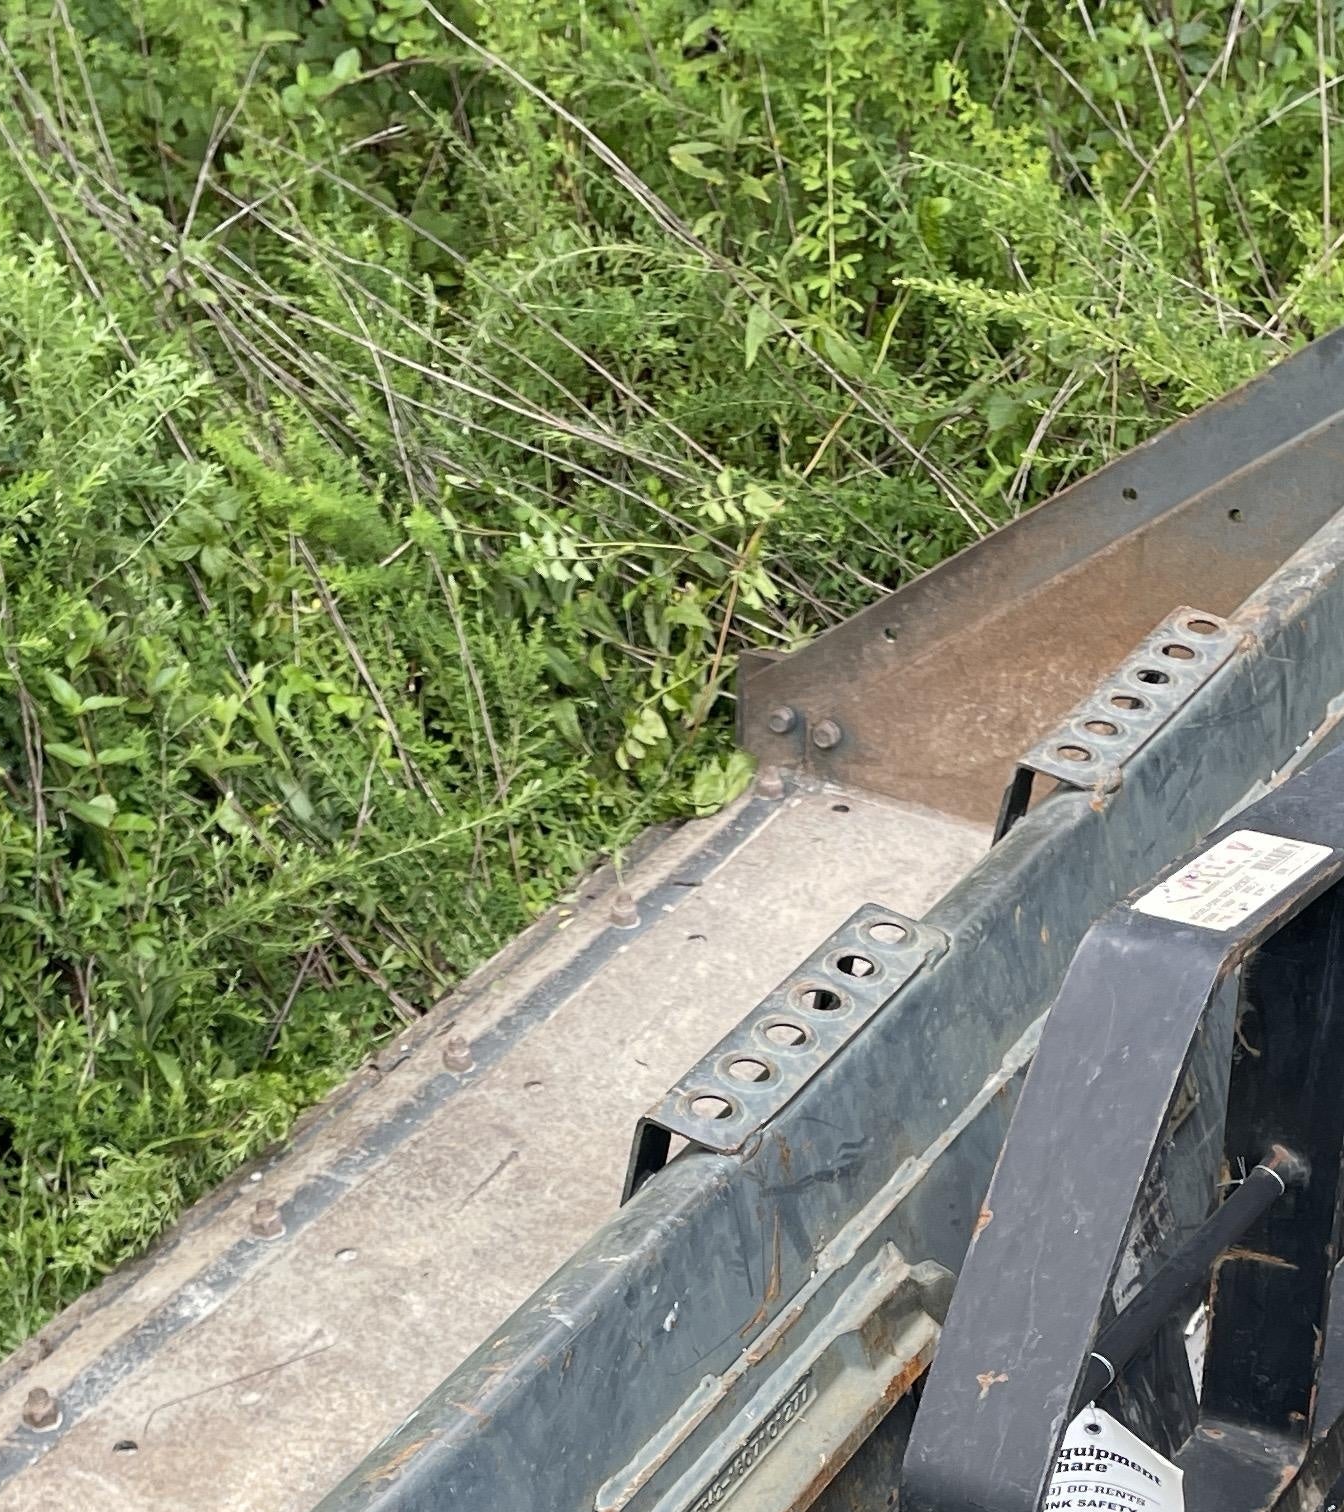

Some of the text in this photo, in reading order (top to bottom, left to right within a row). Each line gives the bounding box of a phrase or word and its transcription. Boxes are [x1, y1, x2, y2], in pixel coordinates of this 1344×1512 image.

[1055, 1461, 1108, 1474] hare
[1058, 1444, 1162, 1488] quipment
[1046, 1499, 1072, 1510] INK
